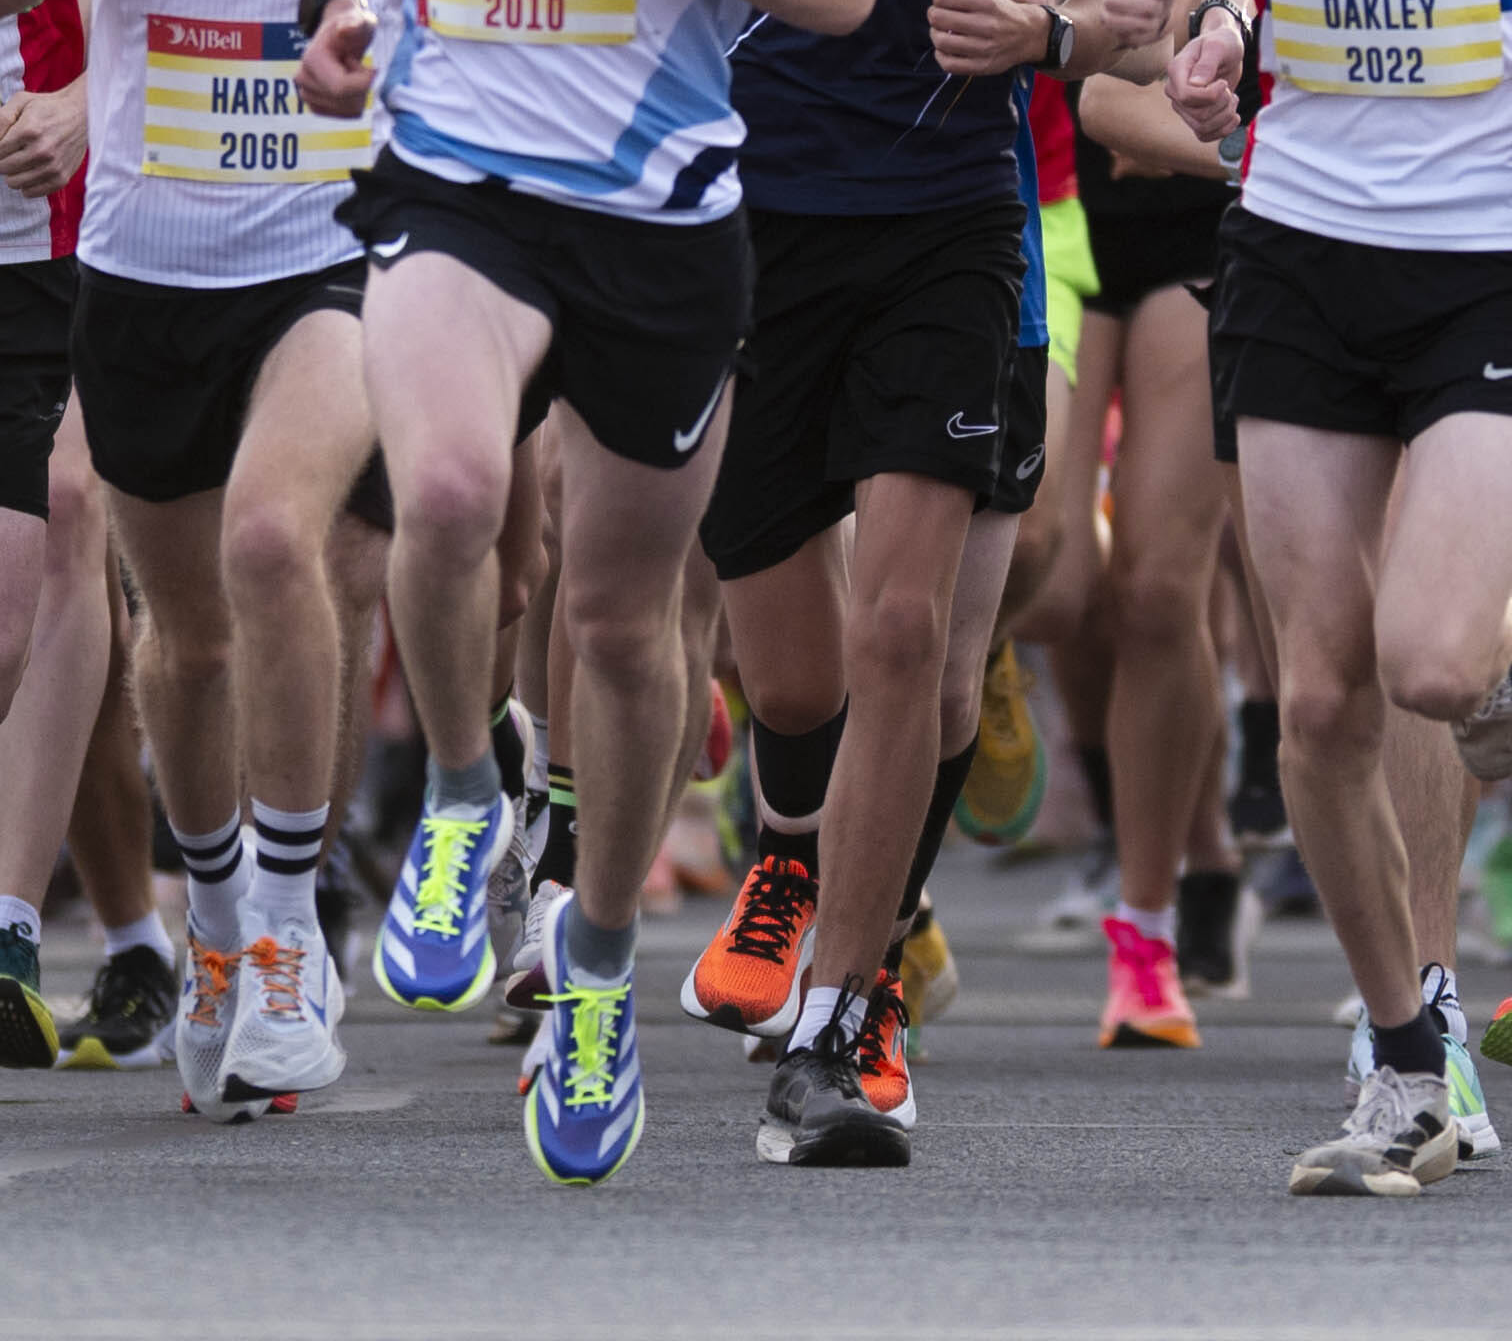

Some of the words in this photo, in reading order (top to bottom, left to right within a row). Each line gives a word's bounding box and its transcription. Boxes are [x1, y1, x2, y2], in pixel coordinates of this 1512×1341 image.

[184, 28, 242, 51] AJBell
[1346, 46, 1425, 83] 2022
[220, 132, 299, 171] 2060
